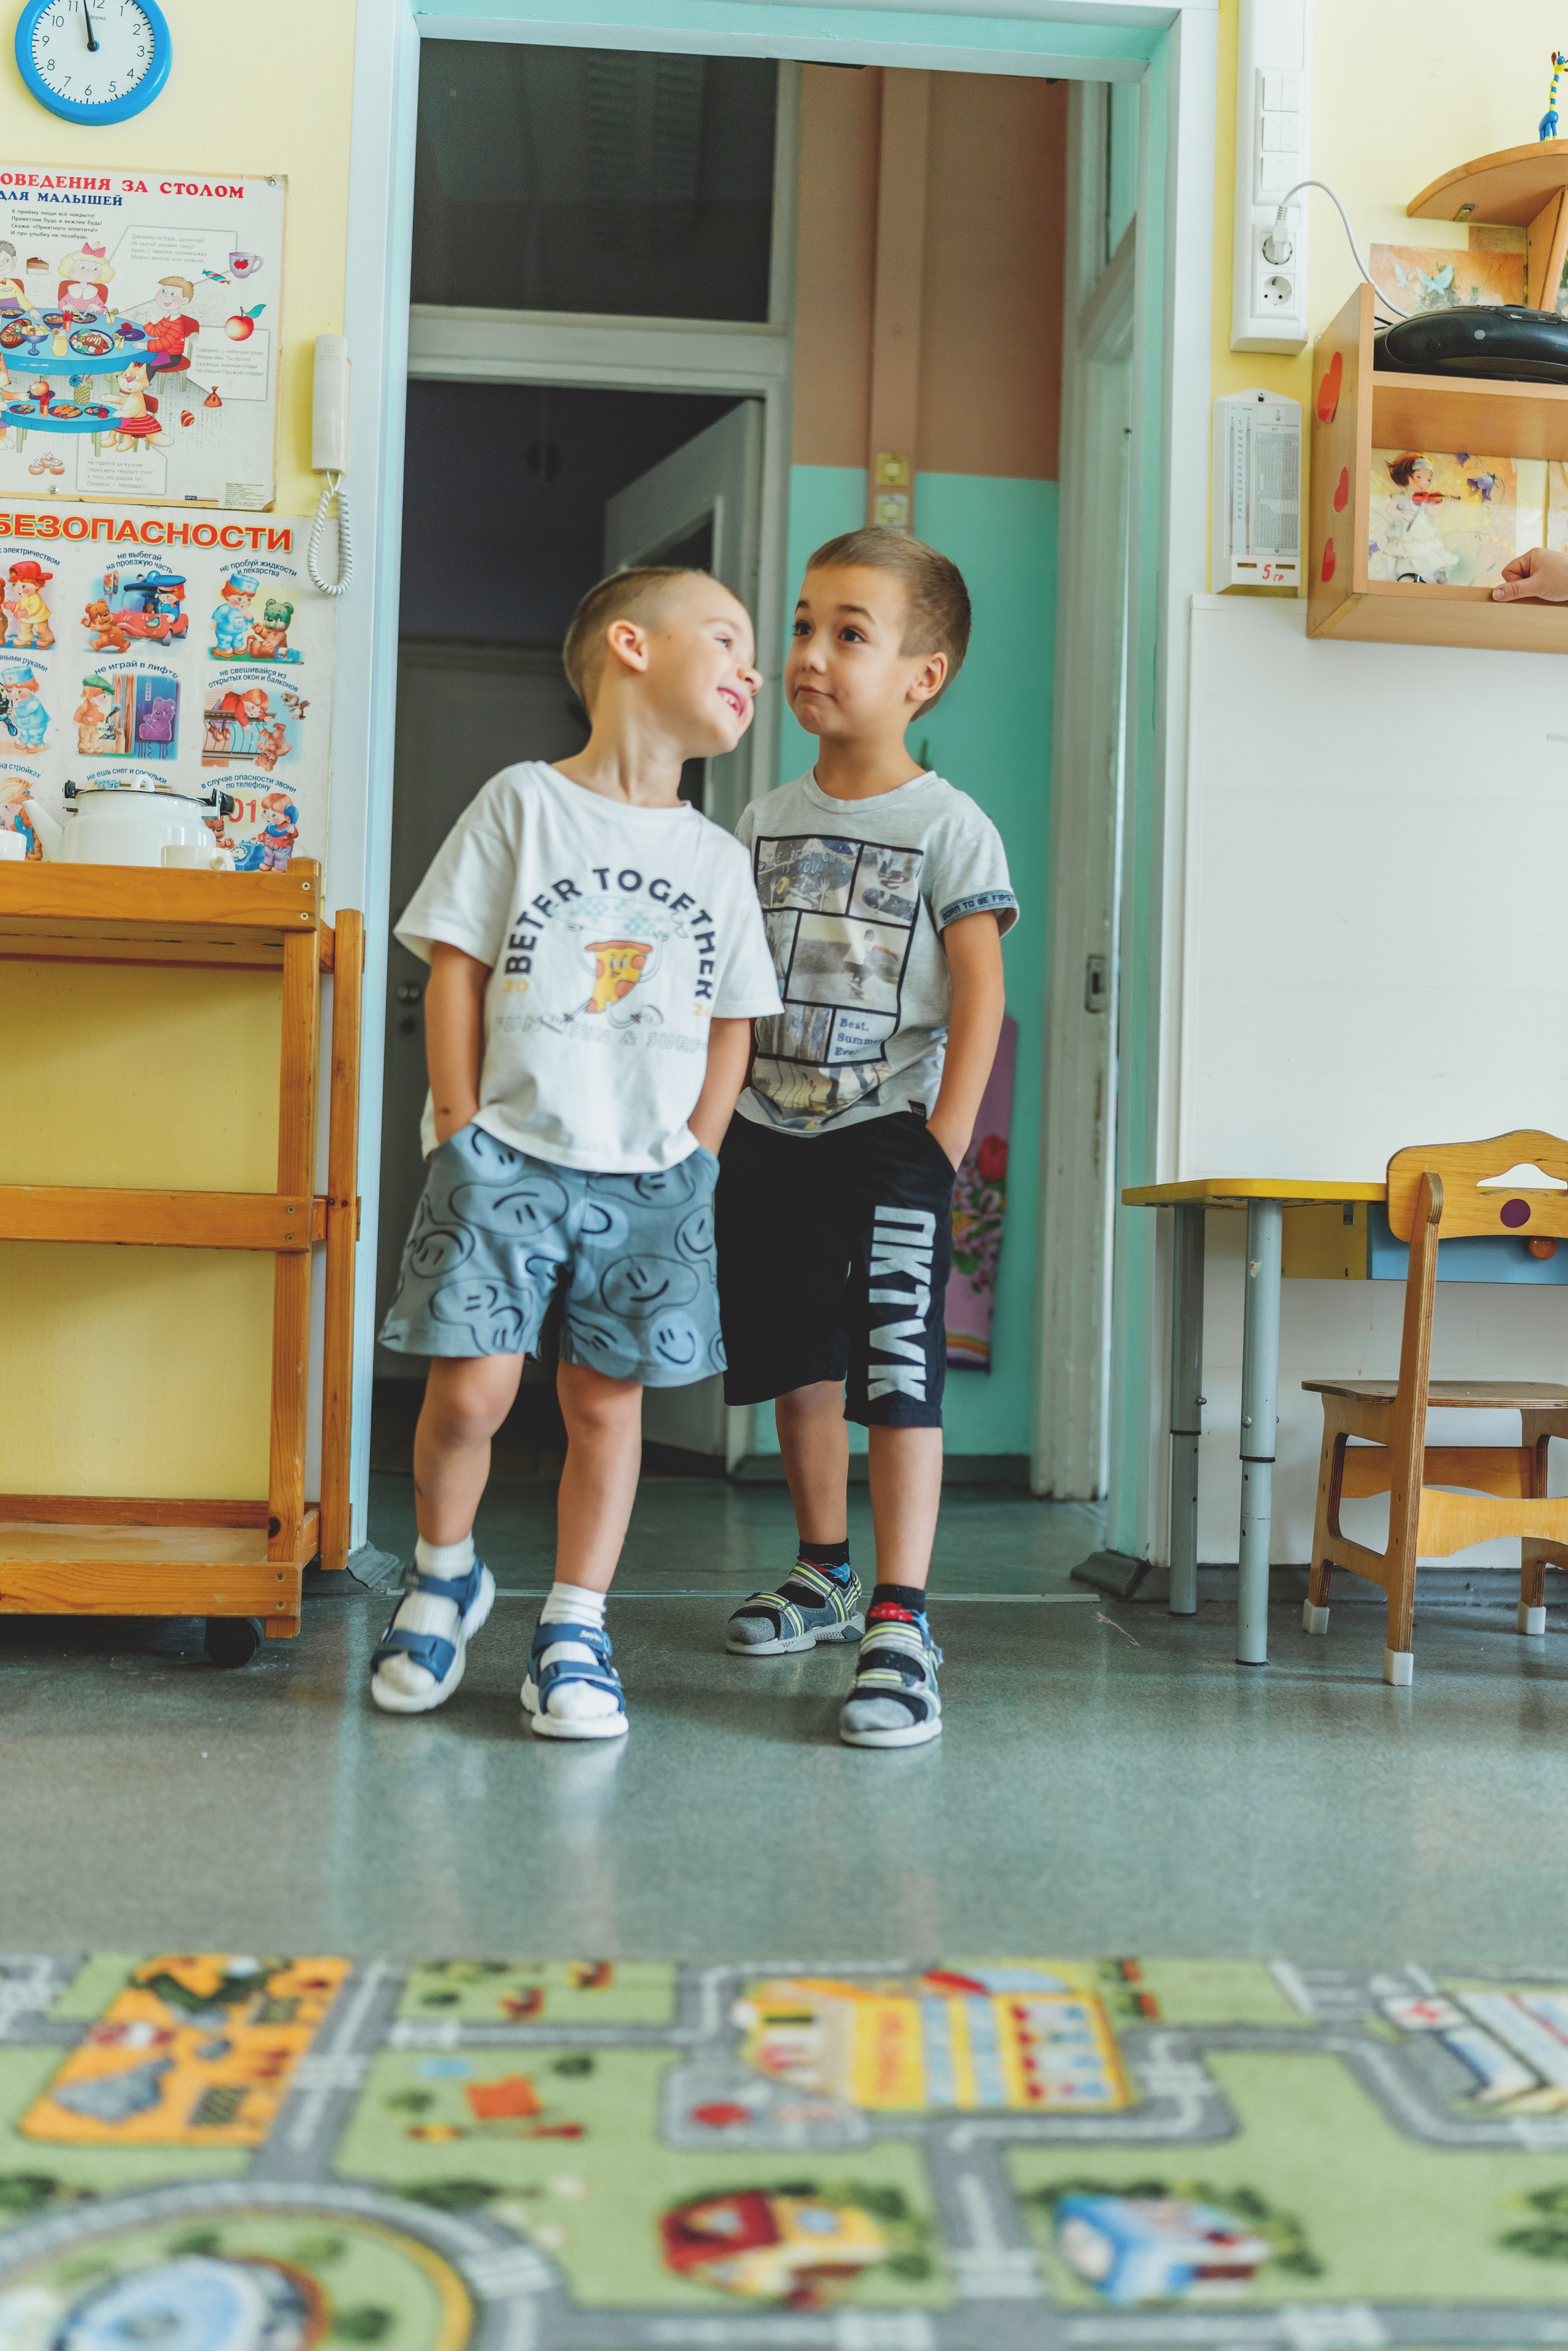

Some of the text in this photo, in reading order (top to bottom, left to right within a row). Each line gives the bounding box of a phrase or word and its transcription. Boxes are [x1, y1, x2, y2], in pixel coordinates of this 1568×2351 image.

[69, 0, 78, 12] 11
[120, 6, 124, 17] 1
[51, 15, 64, 27] 10
[133, 24, 141, 35] 2
[42, 36, 50, 47] 9
[137, 45, 145, 57] 3
[47, 59, 55, 71] 8
[126, 68, 135, 78] 4
[64, 76, 72, 87] 7
[108, 81, 116, 92] 5
[85, 85, 92, 96] 6
[122, 179, 148, 192] ЗА
[159, 182, 244, 198] СТОЛОМ
[37, 192, 123, 206] МАЛЫШЕЙ
[3, 547, 60, 566] электричеством
[129, 551, 162, 561] выбегай
[116, 559, 153, 568] проезжую
[154, 562, 173, 574] часть
[230, 559, 258, 570] пробуй
[260, 561, 298, 577] жидкости
[243, 568, 280, 577] лекарства
[1262, 564, 1272, 579] 5
[22, 658, 48, 672] руками
[108, 660, 137, 670] играй
[148, 664, 179, 679] лифте
[230, 667, 277, 676] свешивайся
[208, 674, 241, 689] открытых
[266, 674, 299, 692] балконов
[9, 764, 42, 779] стройках
[97, 769, 111, 778] ешь
[207, 775, 233, 787] случае
[234, 774, 274, 784] опасности
[274, 780, 296, 793] звони
[236, 782, 271, 791] телефону
[963, 900, 974, 909] TO
[501, 979, 529, 994] 20
